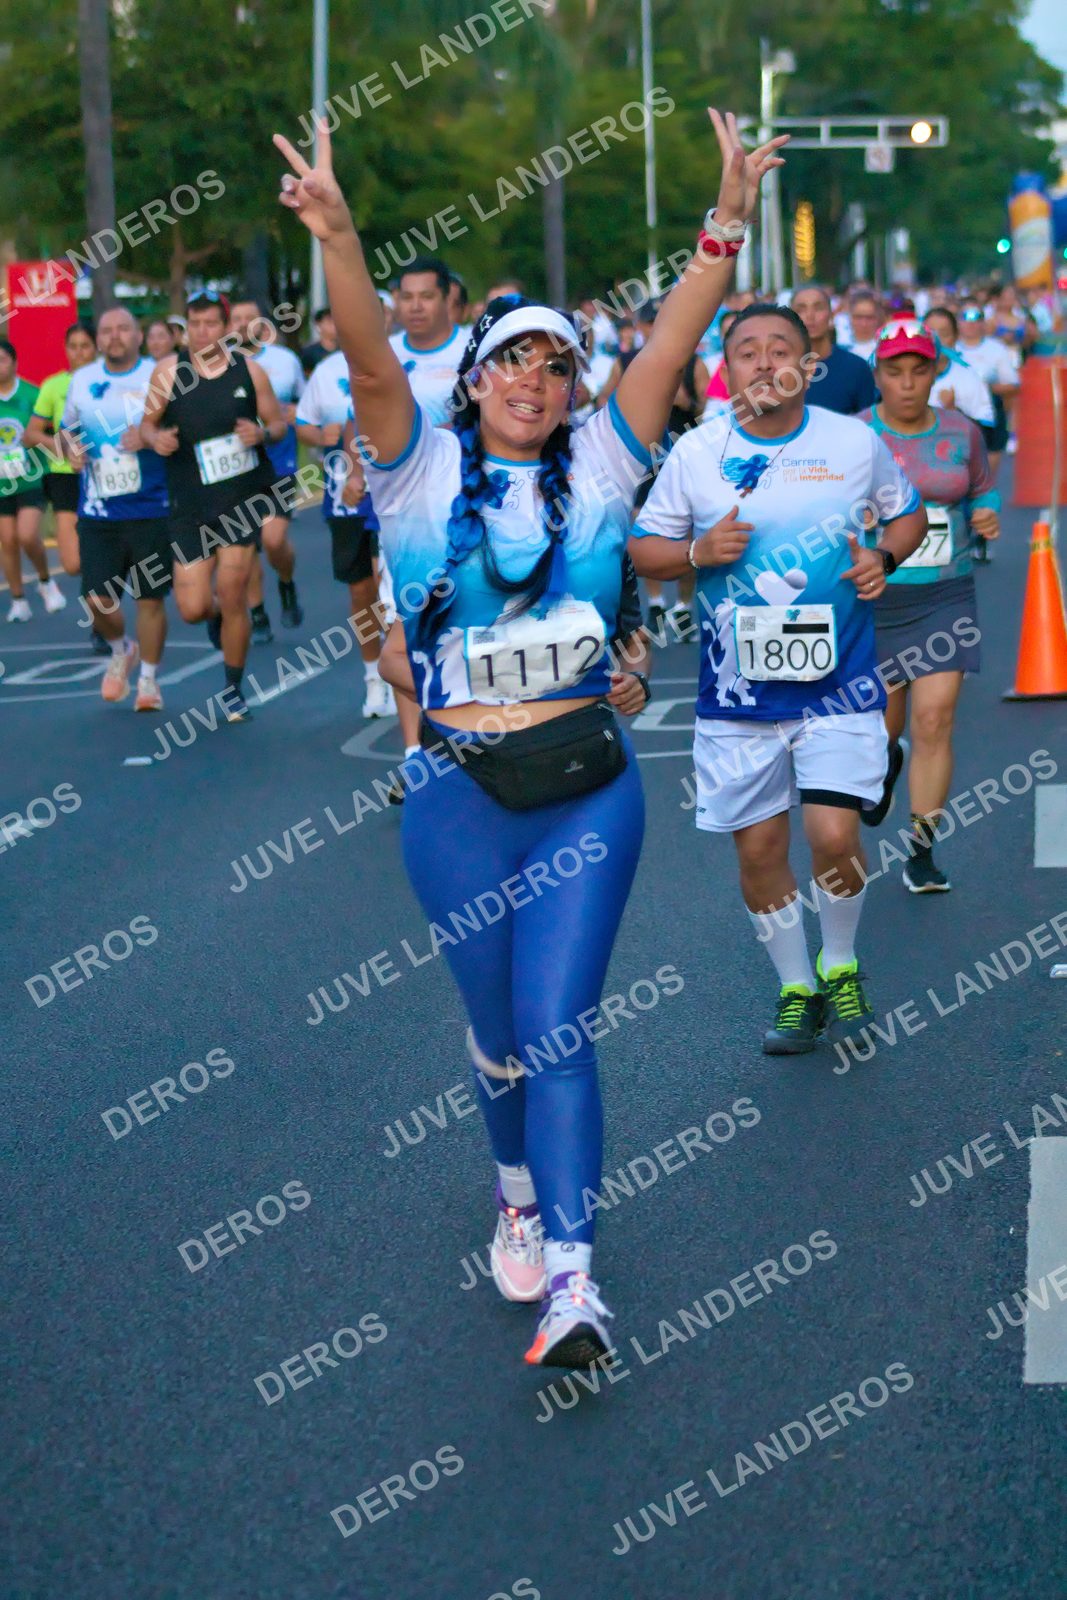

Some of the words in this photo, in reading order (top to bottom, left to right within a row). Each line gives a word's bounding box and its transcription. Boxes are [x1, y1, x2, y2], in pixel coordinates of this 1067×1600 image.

[782, 458, 826, 467] Carrera
[480, 635, 600, 687] 1112
[744, 638, 832, 671] 1800
